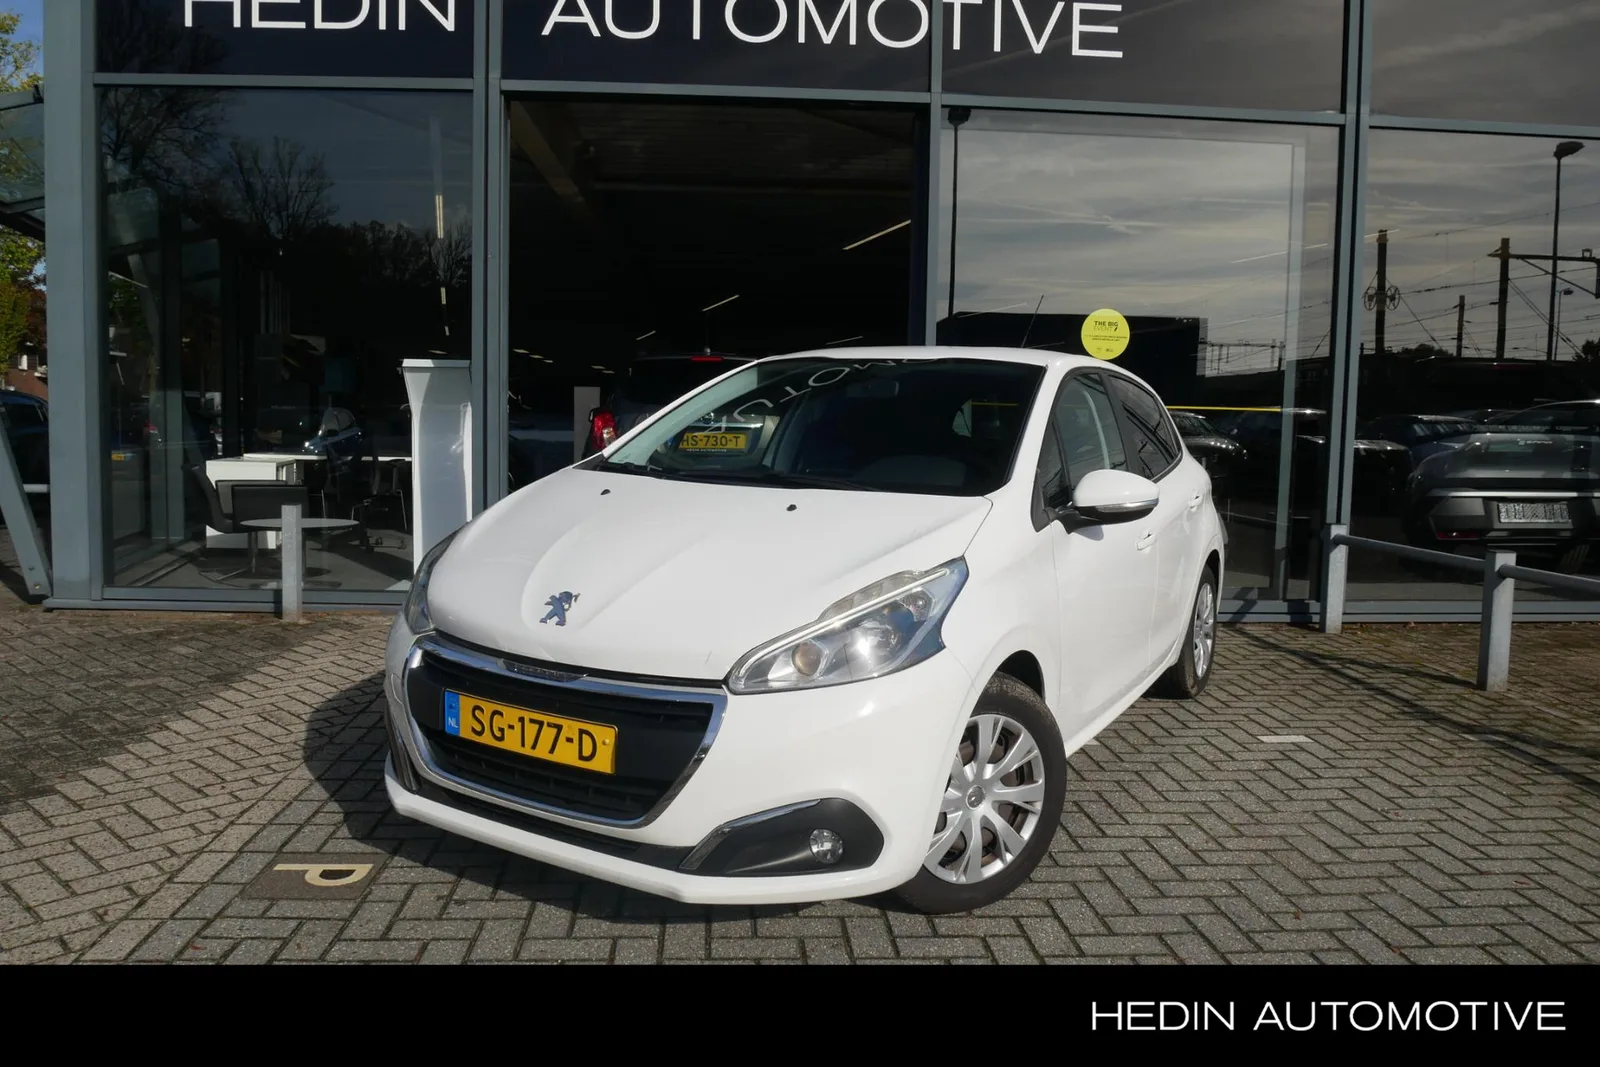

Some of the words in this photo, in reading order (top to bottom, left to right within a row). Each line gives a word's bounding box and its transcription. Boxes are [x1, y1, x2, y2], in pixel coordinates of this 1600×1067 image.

[541, 0, 1124, 58] AUTOMOTIVE
[448, 716, 459, 729] NL
[471, 704, 598, 762] SG-177-D
[273, 863, 374, 887] P
